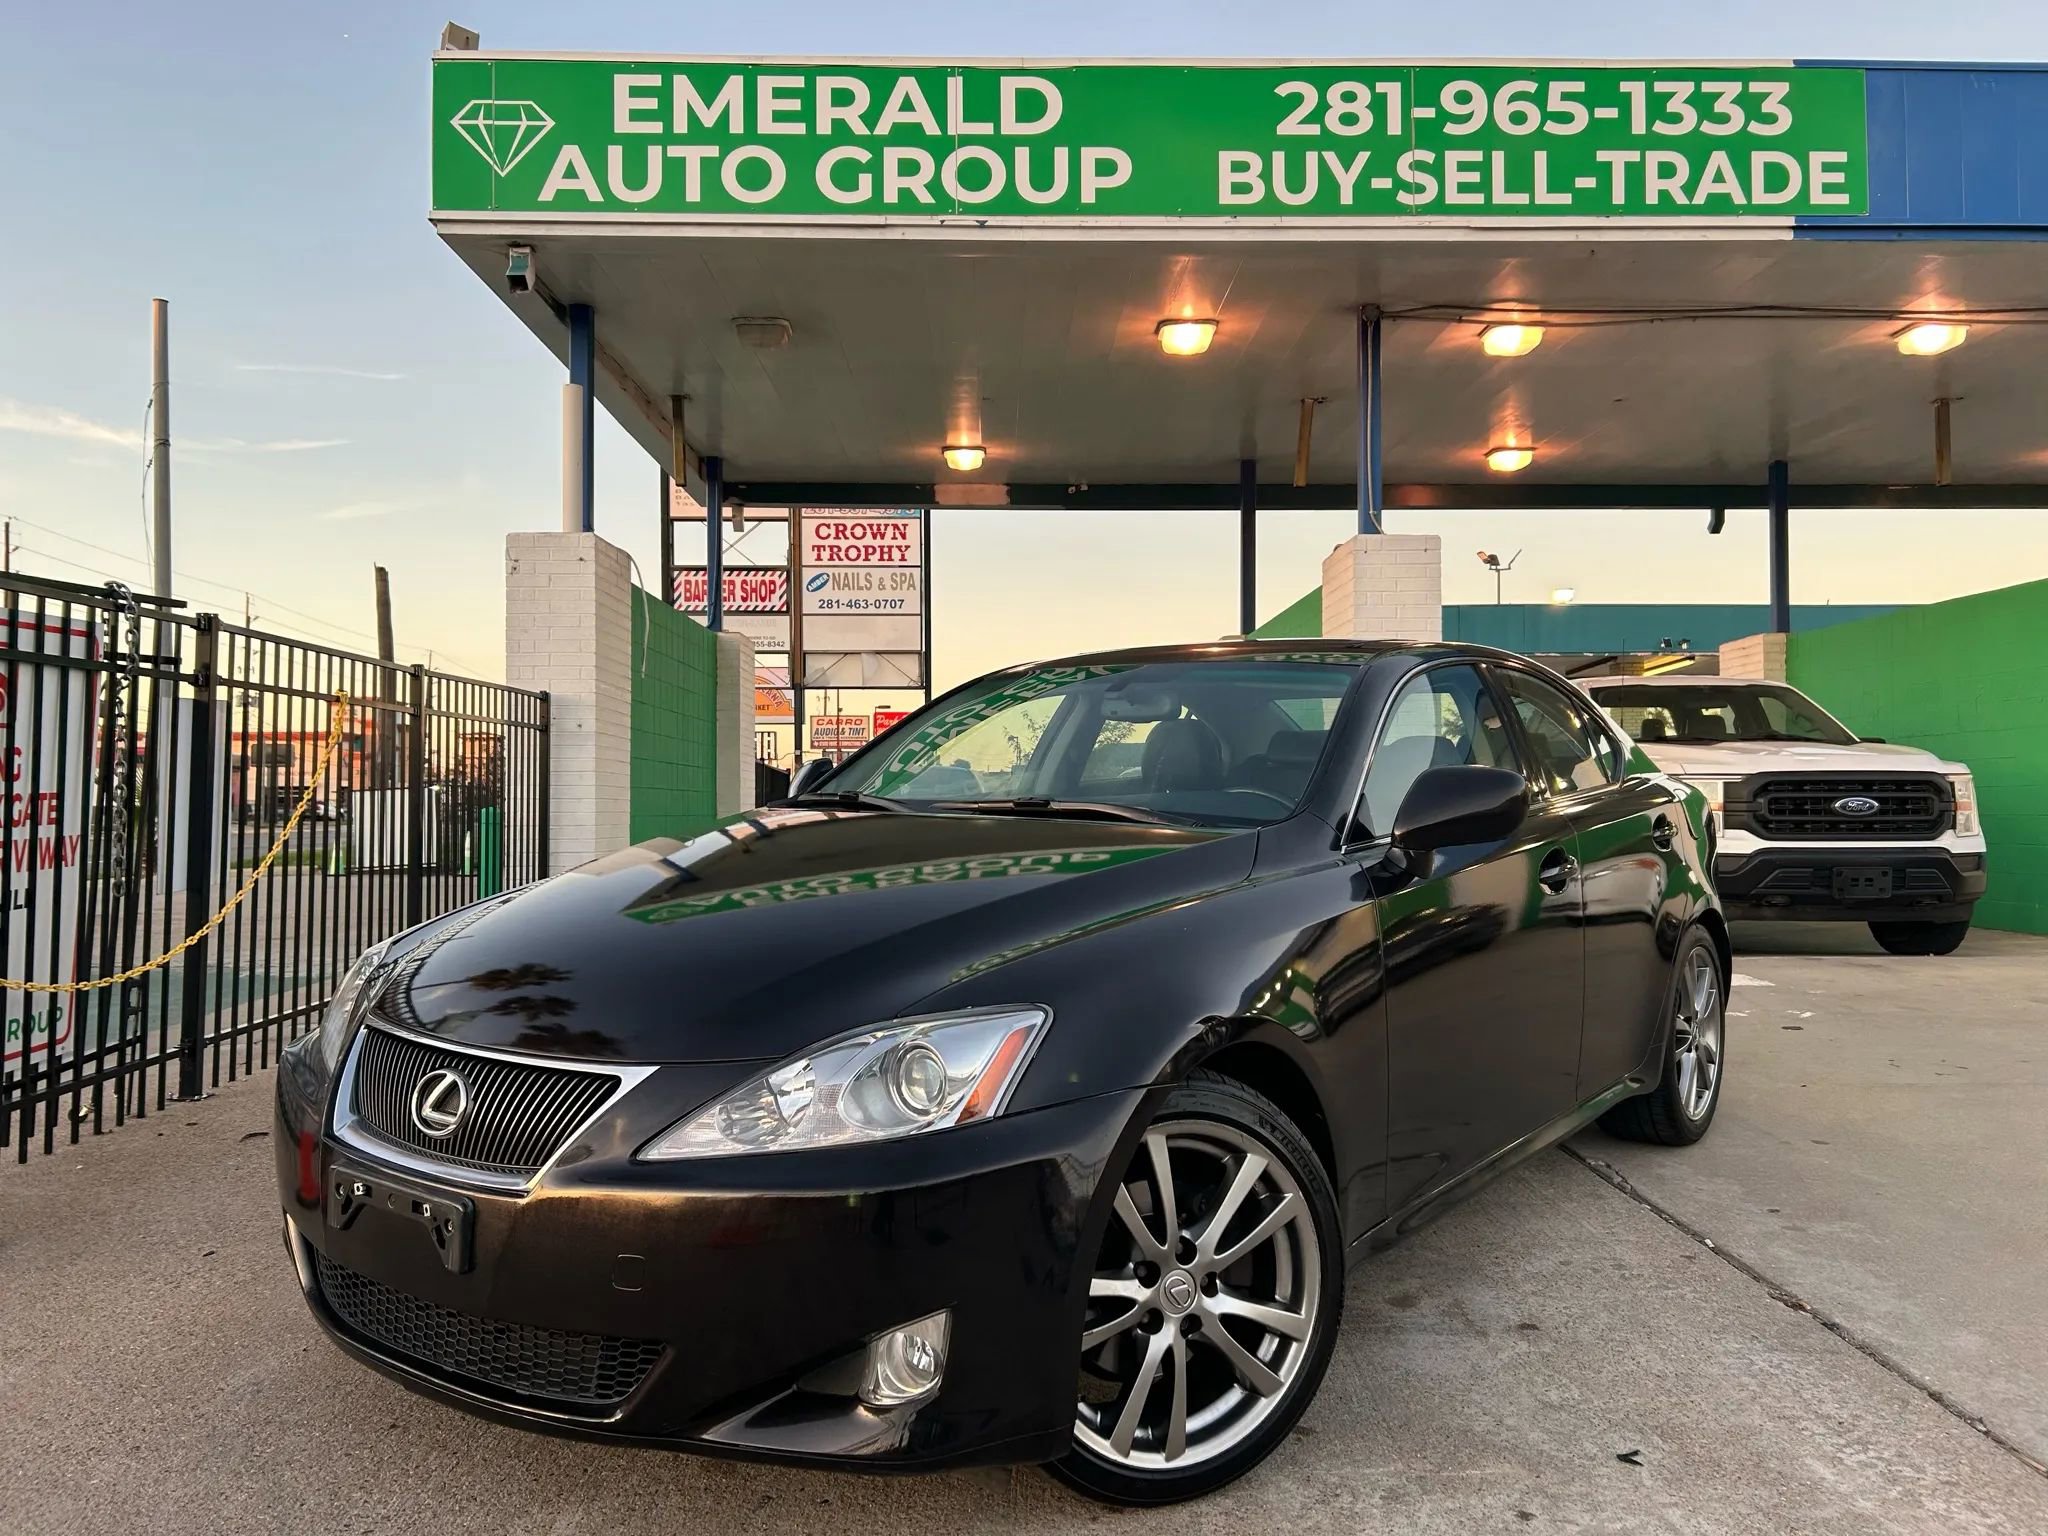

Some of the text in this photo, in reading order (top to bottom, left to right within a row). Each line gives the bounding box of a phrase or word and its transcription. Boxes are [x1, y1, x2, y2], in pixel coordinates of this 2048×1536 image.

[612, 73, 1064, 137] EMERALD
[1273, 80, 1794, 137] 281-965-1333
[537, 144, 1133, 206] AUTO GROUP
[1217, 149, 1851, 207] BUY-SELL-TRADE
[815, 522, 909, 541] CROWN
[811, 544, 911, 562] TROPHY
[683, 579, 777, 603] BARER SHOP
[831, 572, 917, 591] NAILS & SPA
[818, 598, 905, 610] 281-463-0707
[816, 718, 863, 726] CARRO
[848, 727, 866, 737] TINT
[1846, 799, 1870, 811] Ford
[7, 1006, 63, 1043] ROUP
